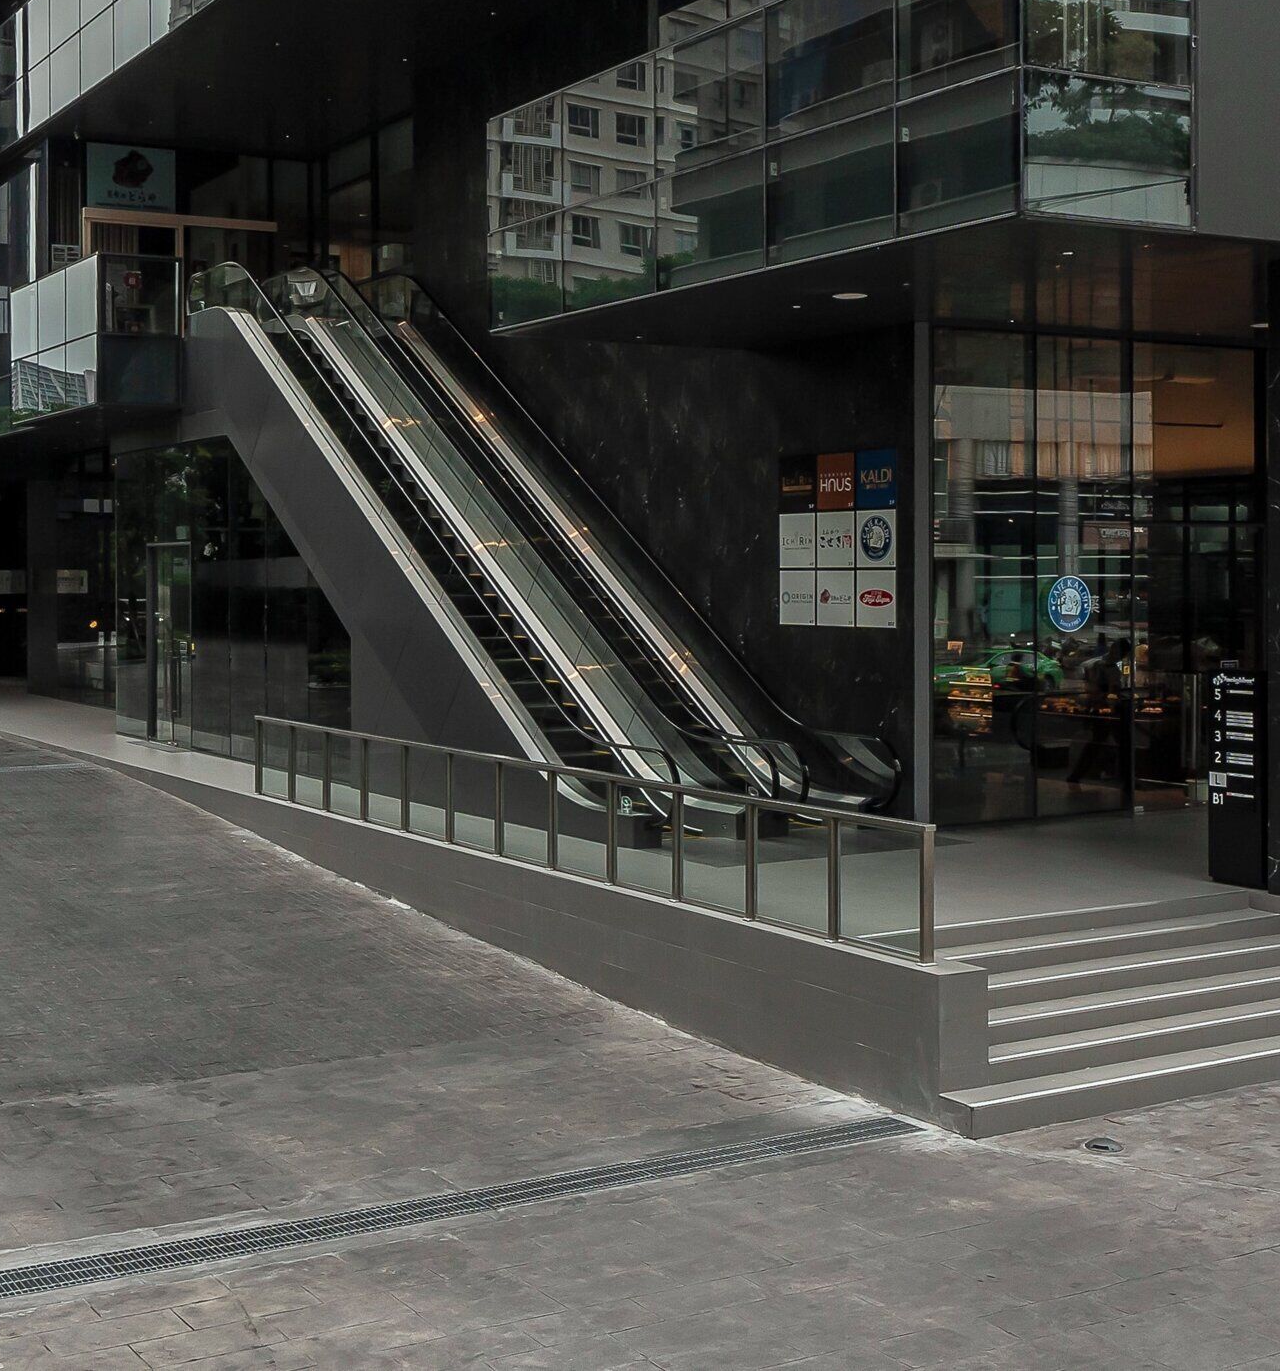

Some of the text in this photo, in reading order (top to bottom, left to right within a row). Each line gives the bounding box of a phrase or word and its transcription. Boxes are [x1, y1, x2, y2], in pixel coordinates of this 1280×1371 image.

[860, 469, 892, 483] KALDI
[819, 477, 852, 492] HAUS
[1067, 579, 1089, 602] KALDI
[1214, 689, 1221, 700] 5
[1214, 710, 1222, 721] 4
[1214, 731, 1221, 742] 3
[1214, 752, 1222, 763] 2
[1212, 793, 1223, 805] B1
